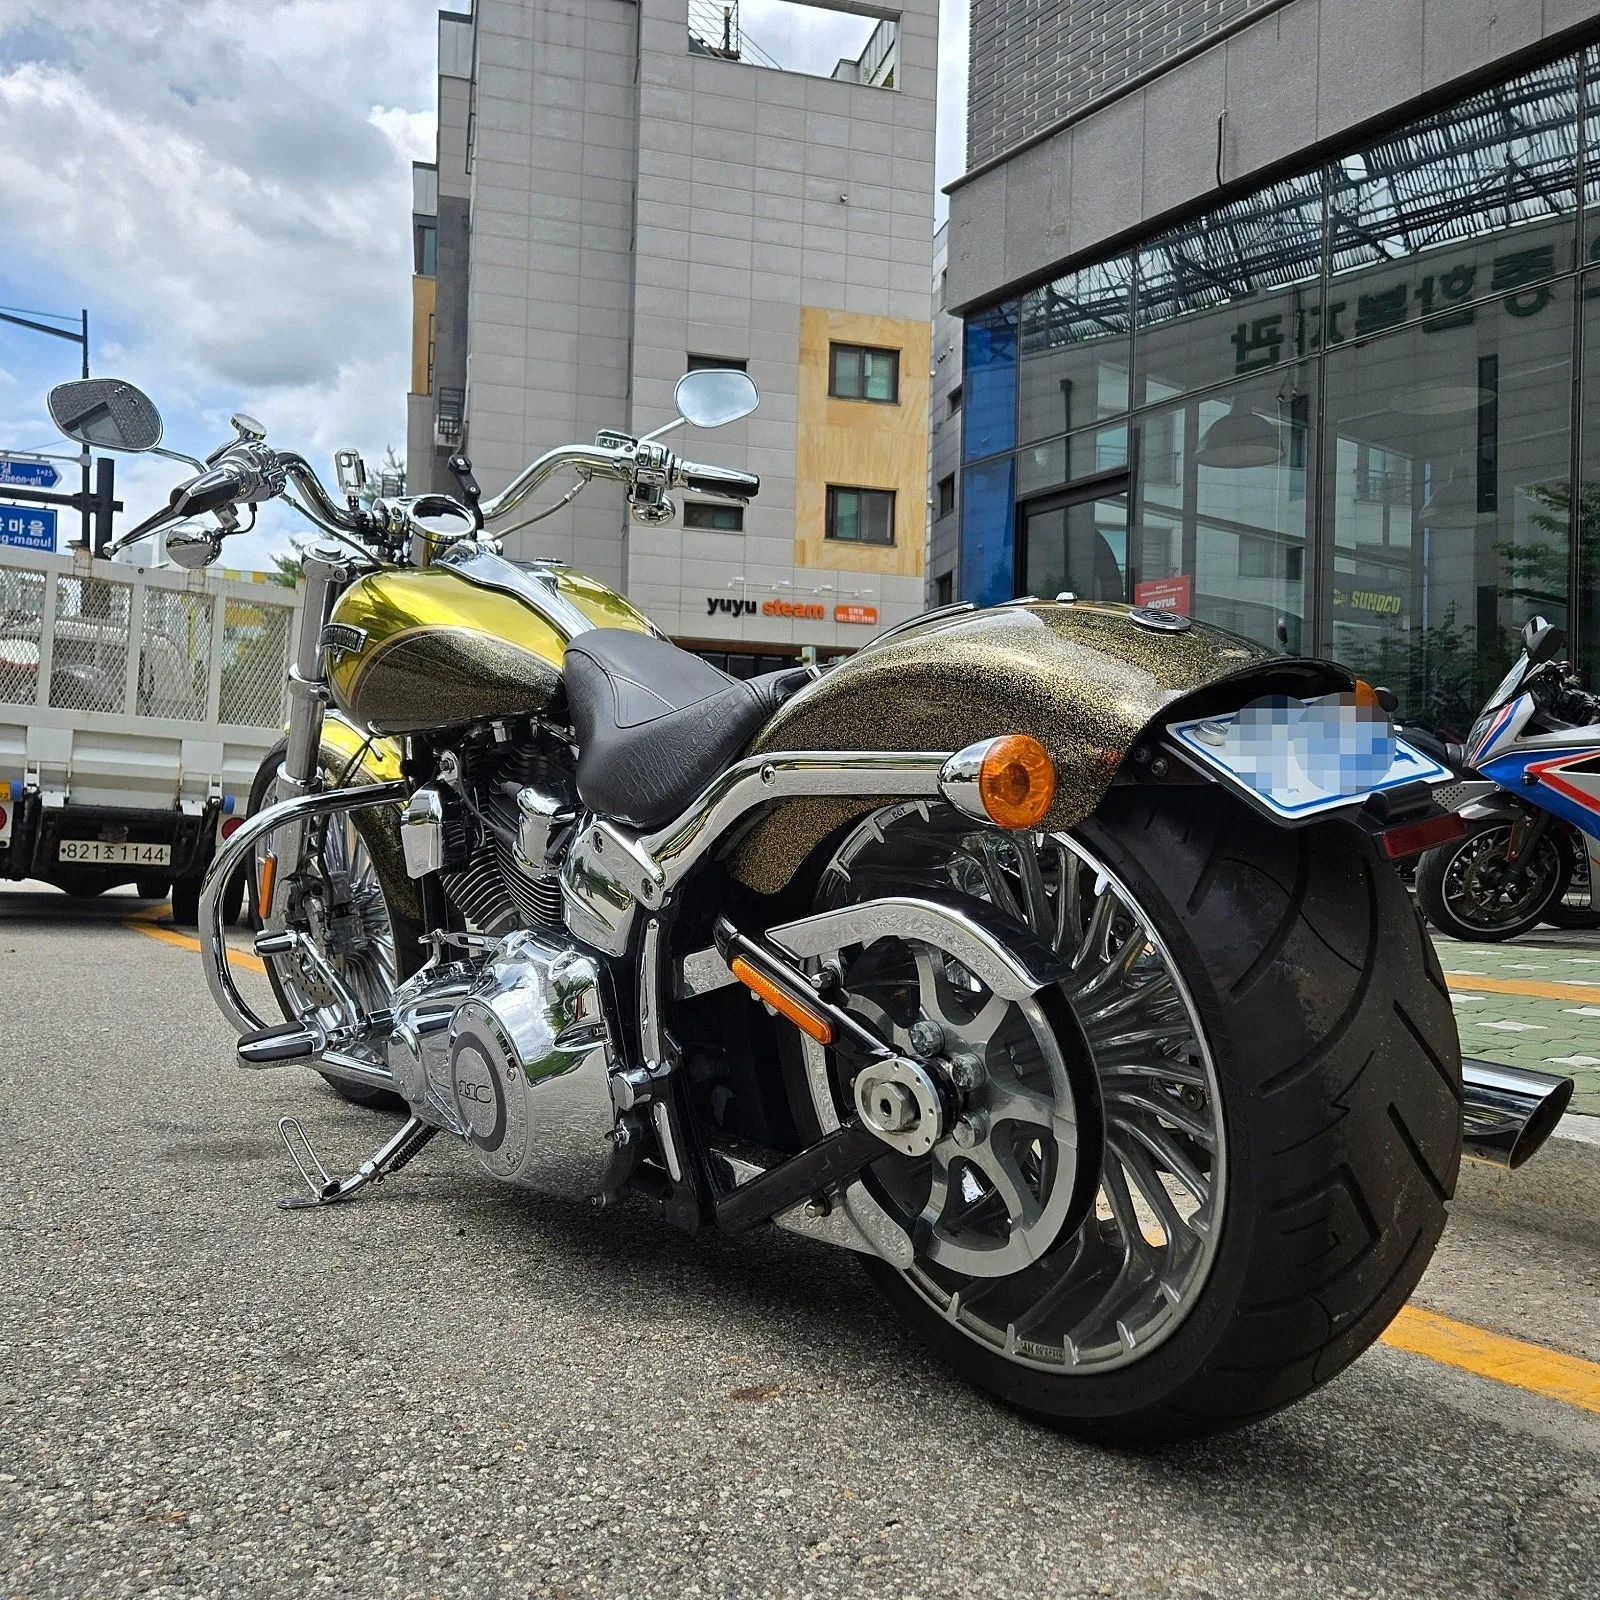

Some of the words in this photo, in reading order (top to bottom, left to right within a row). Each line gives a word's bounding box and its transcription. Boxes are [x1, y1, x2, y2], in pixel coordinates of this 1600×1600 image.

[707, 597, 757, 617] yuyu
[762, 597, 825, 619] steam
[1147, 597, 1176, 609] MOTUL
[1351, 590, 1401, 614] SUNOCO
[66, 843, 165, 863] 821조1144
